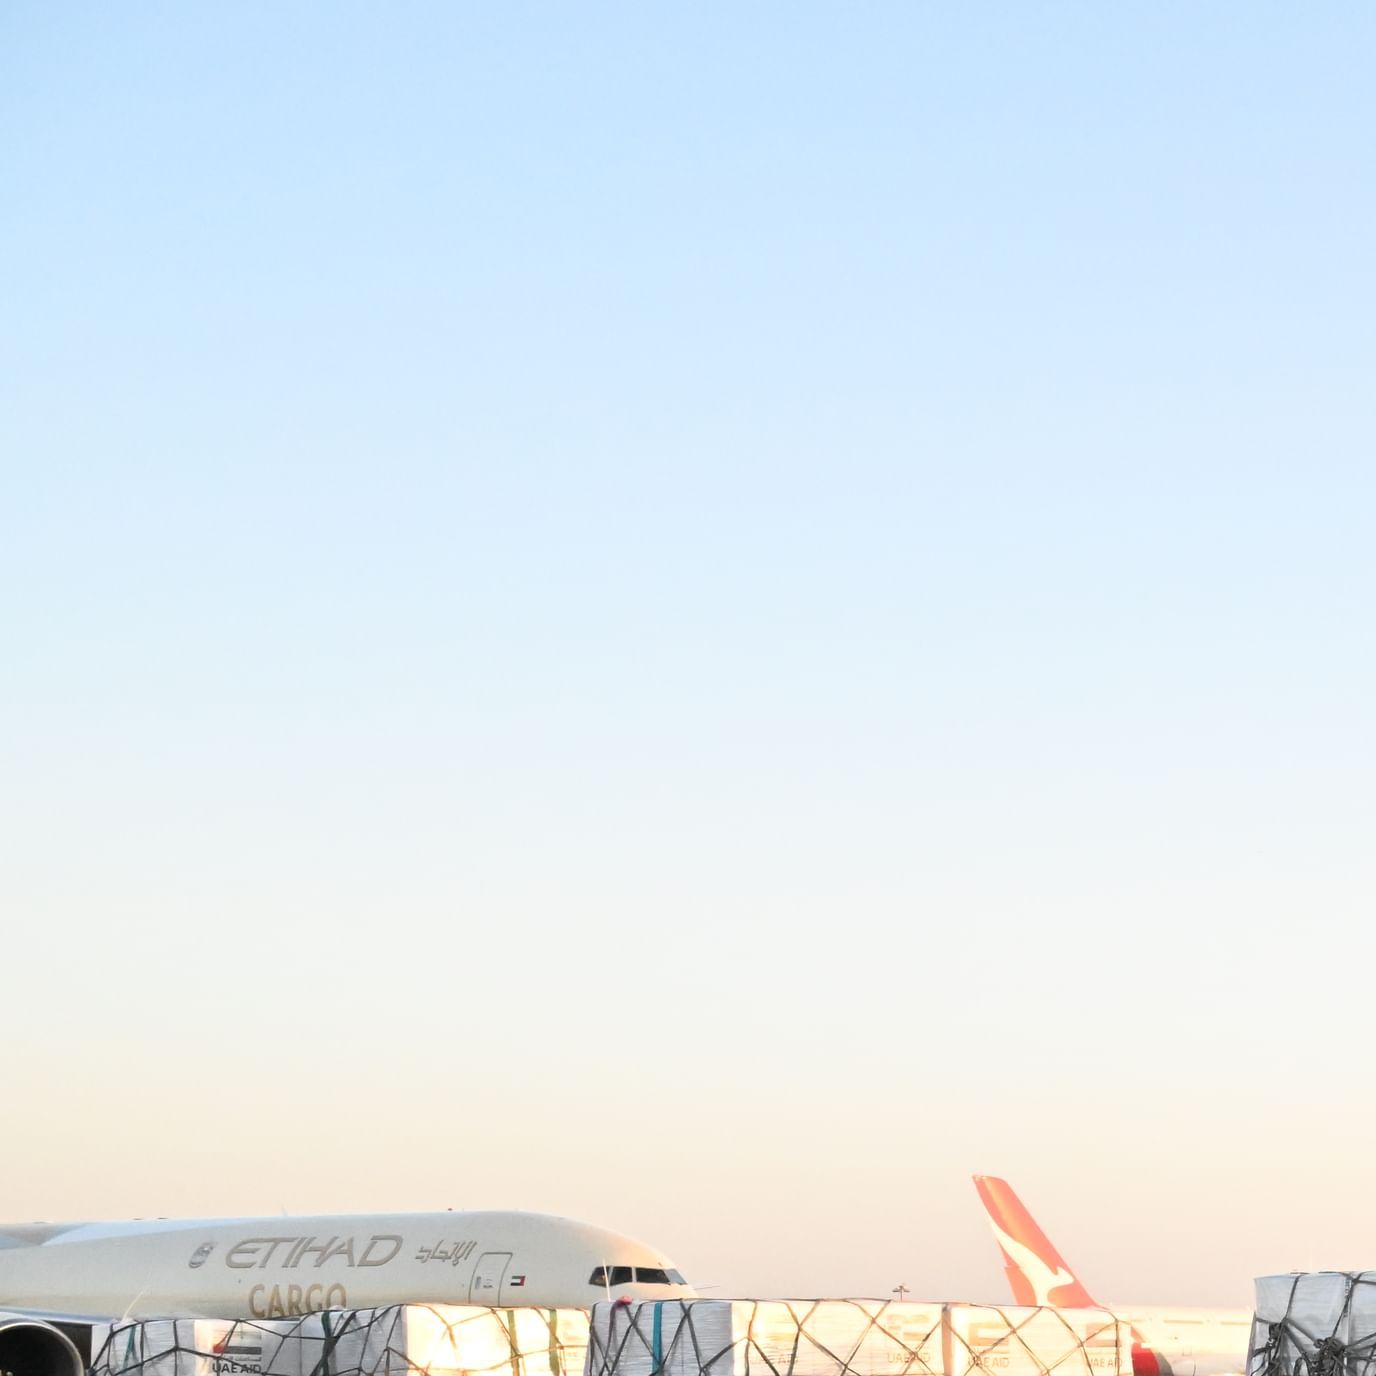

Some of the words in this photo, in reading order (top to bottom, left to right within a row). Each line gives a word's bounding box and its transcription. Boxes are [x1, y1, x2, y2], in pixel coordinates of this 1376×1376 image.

[225, 1235, 404, 1268] ETIHAD
[250, 1283, 347, 1318] CARGO
[212, 1363, 238, 1373] UAE
[239, 1363, 262, 1374] AID
